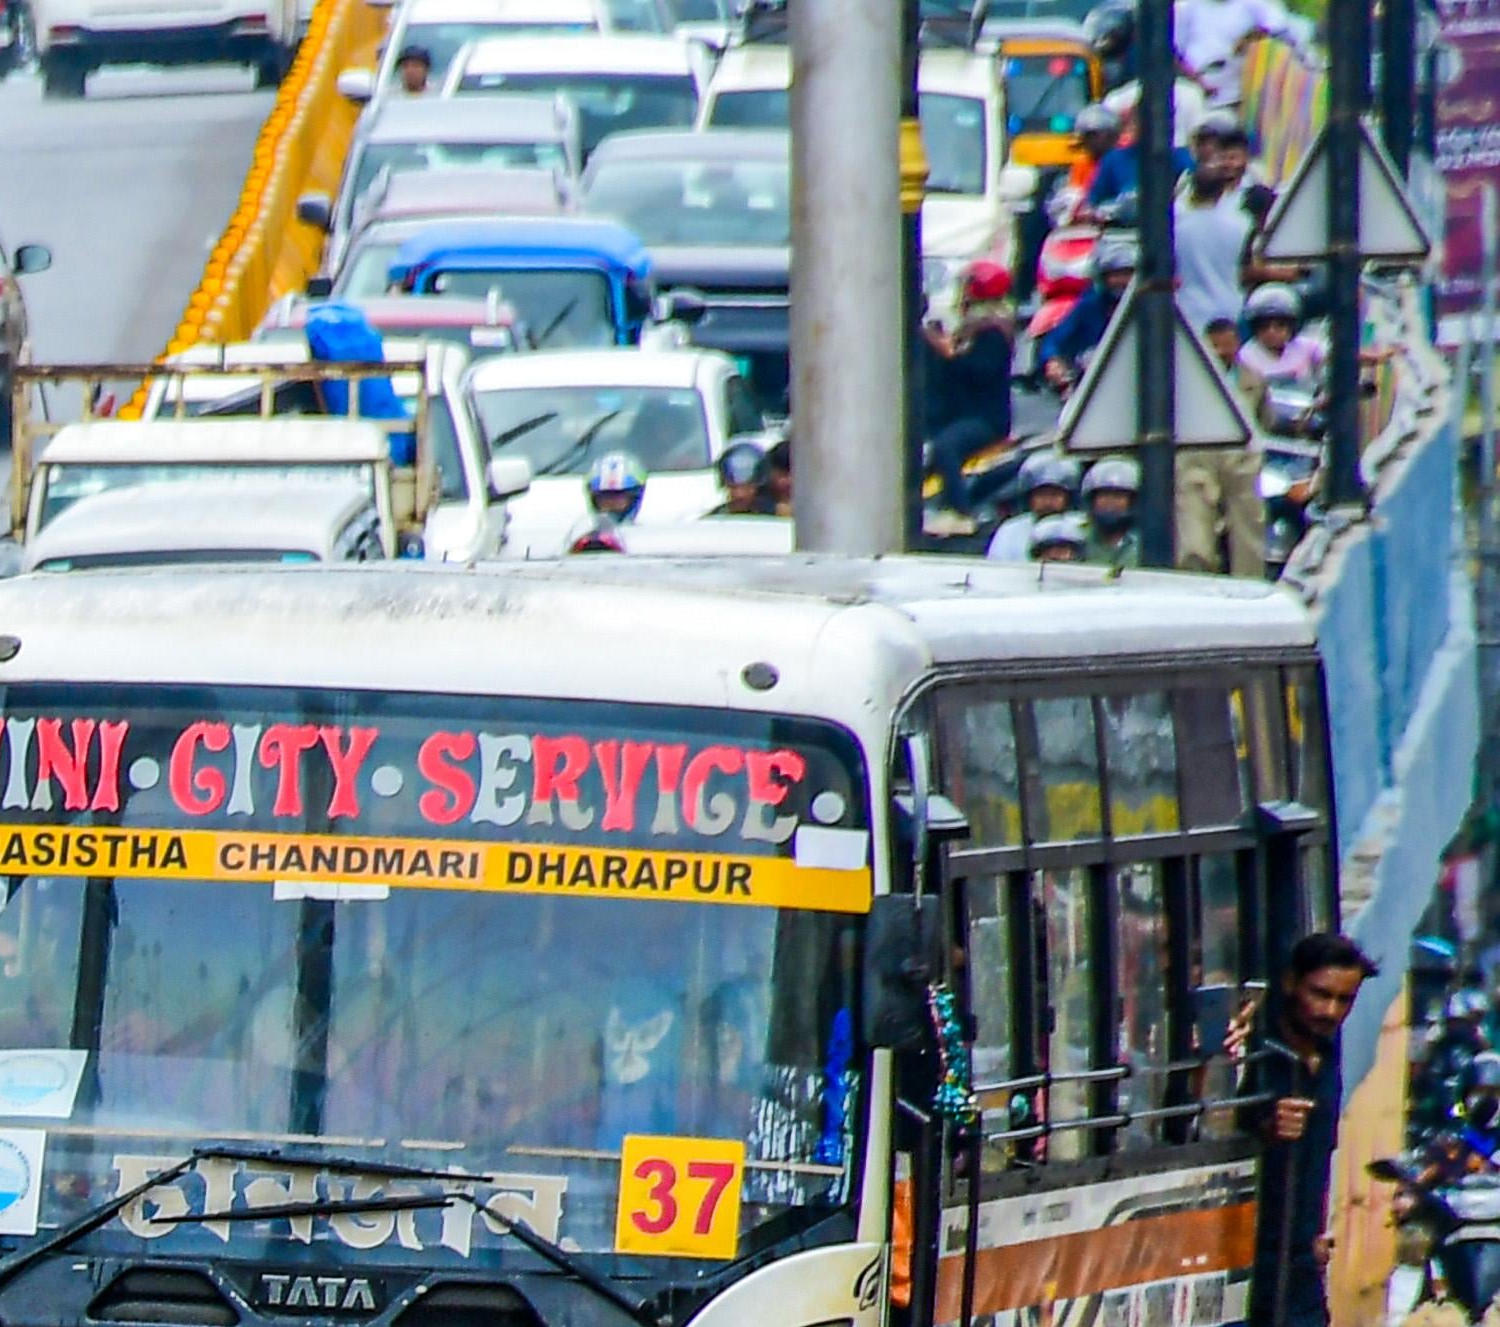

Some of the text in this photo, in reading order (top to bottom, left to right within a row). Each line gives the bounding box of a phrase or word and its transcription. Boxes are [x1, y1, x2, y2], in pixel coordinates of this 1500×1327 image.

[169, 721, 379, 820] CITY
[417, 729, 805, 845] SERVICE
[220, 842, 480, 880] CHANDMARI
[506, 850, 753, 897] DHARAPUR
[630, 1158, 736, 1235] 37
[261, 1274, 376, 1310] TATA
